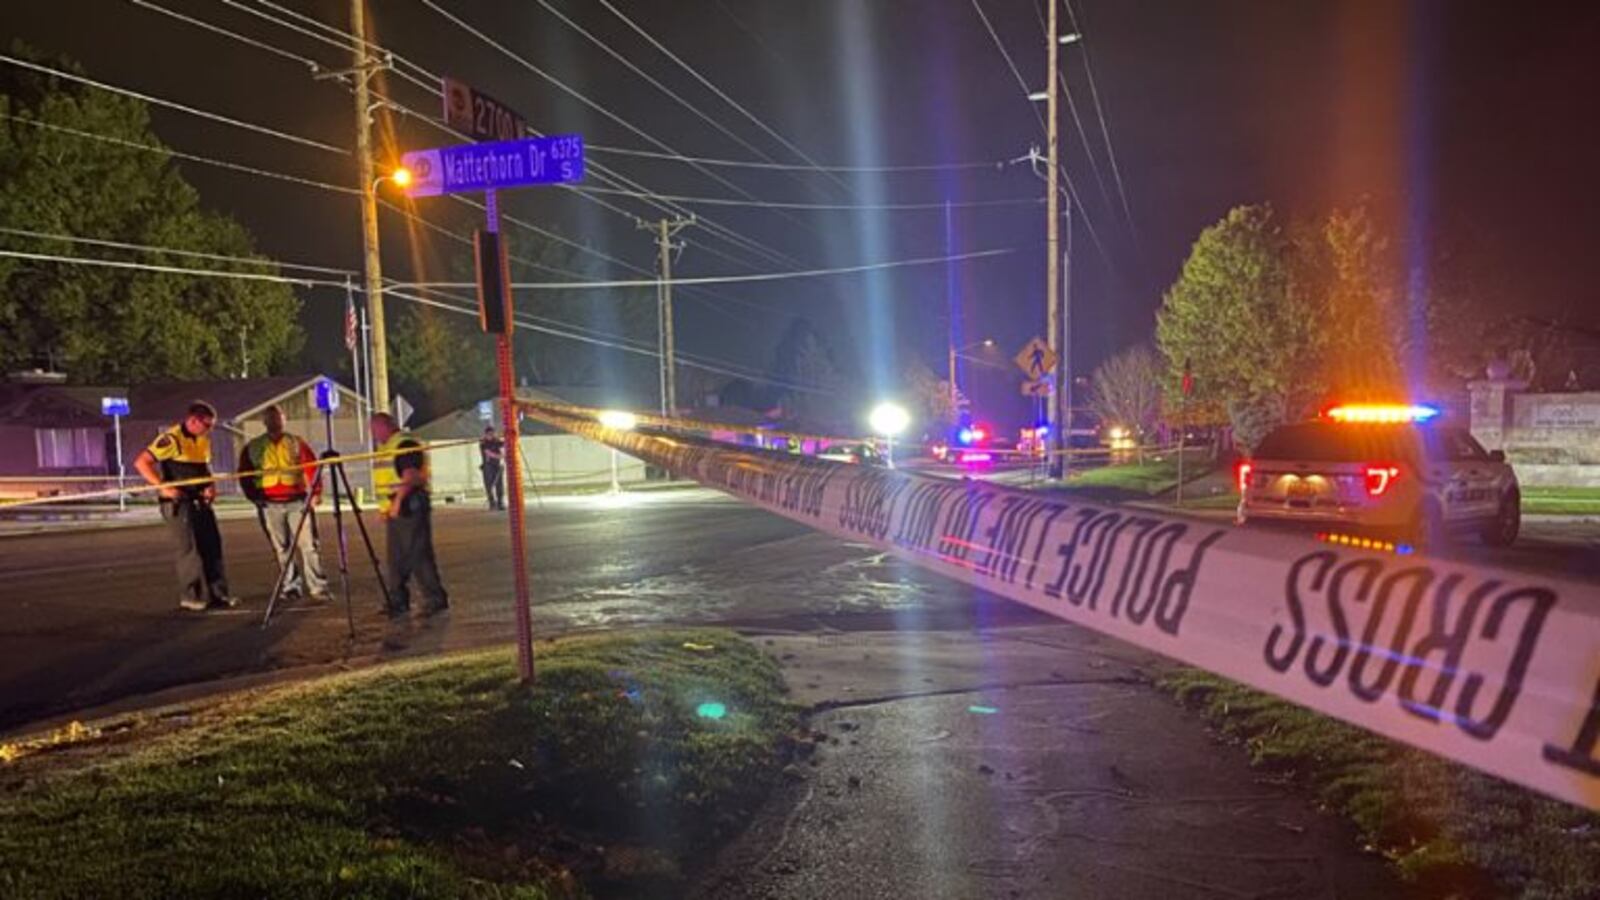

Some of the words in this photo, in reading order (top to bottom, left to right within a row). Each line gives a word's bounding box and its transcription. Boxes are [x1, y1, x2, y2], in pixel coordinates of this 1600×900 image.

[475, 97, 514, 141] 2700
[444, 149, 523, 184] Matterhorn
[528, 143, 546, 178] Dr
[551, 137, 580, 159] 6375
[561, 161, 573, 179] S
[973, 496, 1069, 589] LINE
[1044, 506, 1223, 636] POLICE
[1264, 550, 1560, 740] CROSS
